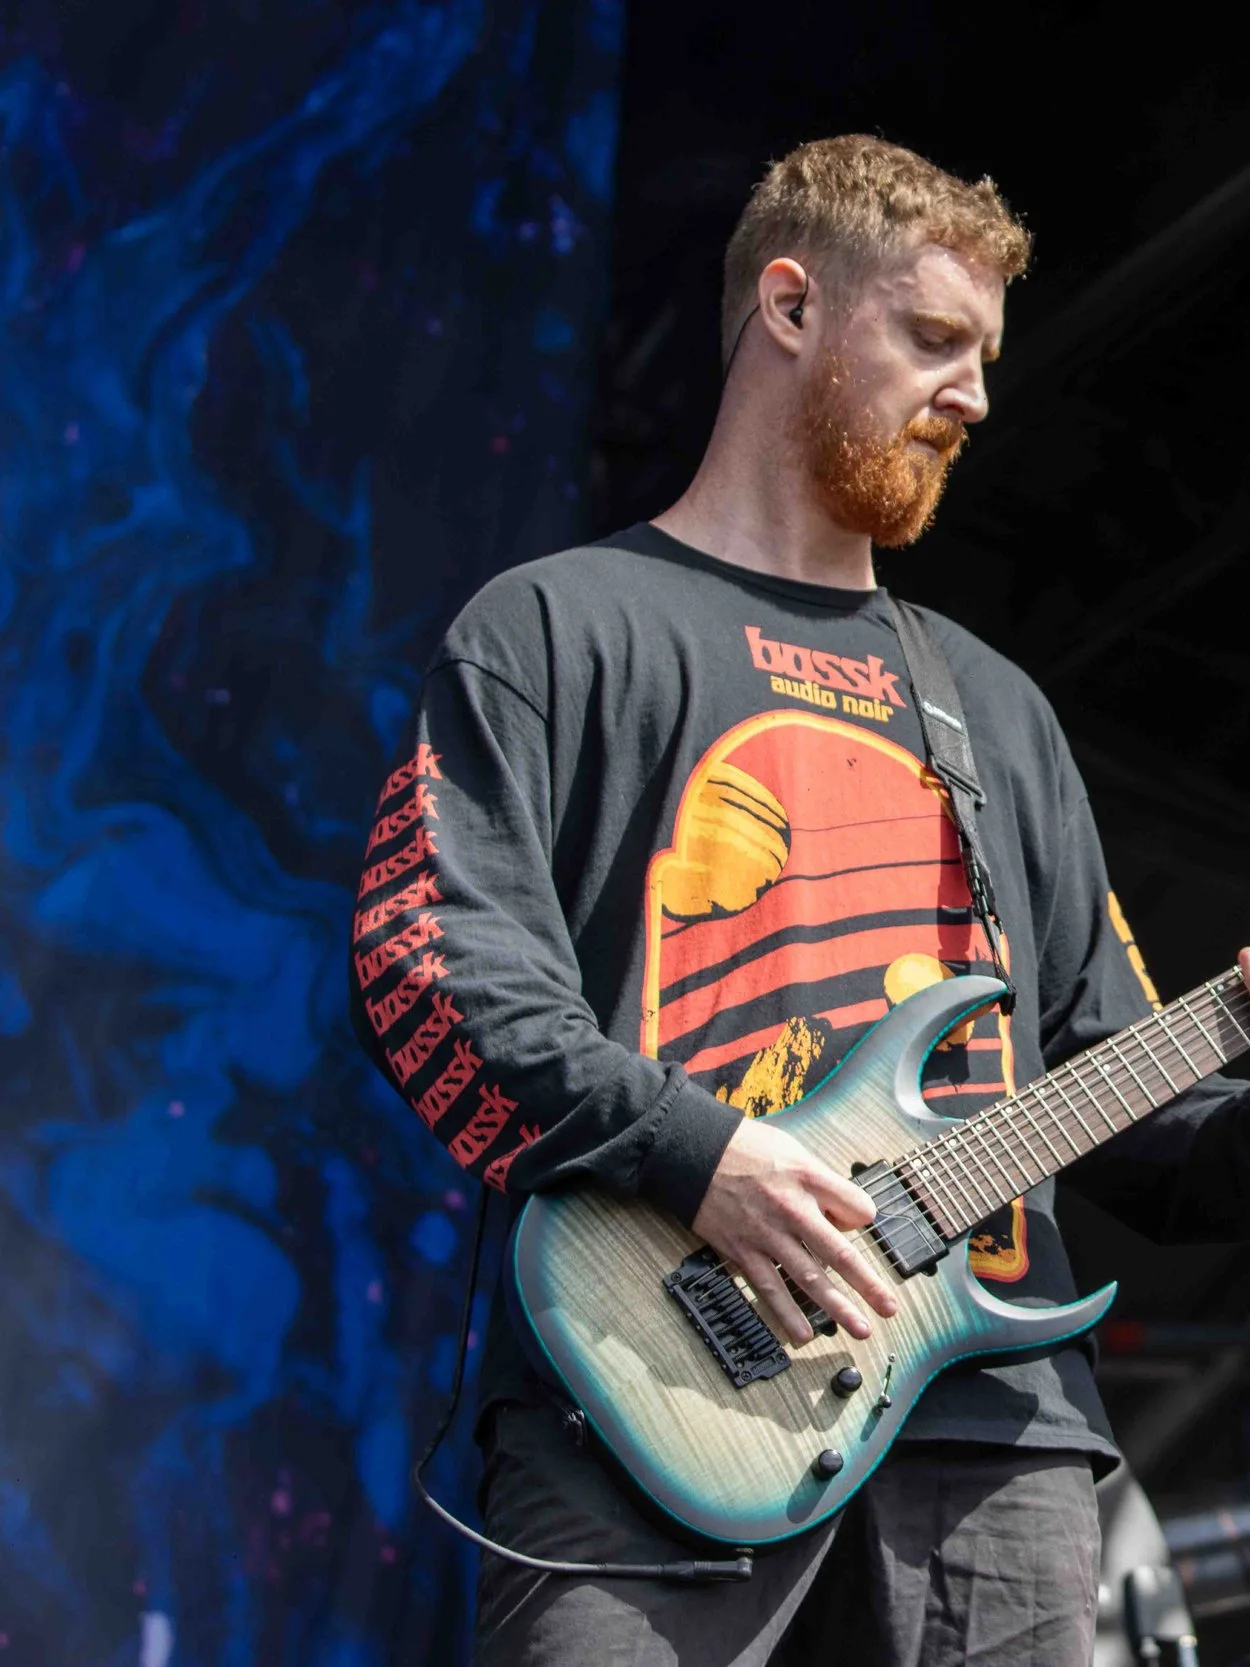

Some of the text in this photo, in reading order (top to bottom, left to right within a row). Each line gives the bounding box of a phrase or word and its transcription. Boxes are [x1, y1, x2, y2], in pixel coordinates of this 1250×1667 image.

[744, 625, 907, 708] bossk
[769, 675, 837, 710] audio
[842, 694, 894, 722] noir
[375, 743, 443, 818] ssk
[365, 783, 439, 860] ossk
[353, 870, 444, 944] bossk
[354, 911, 445, 991] bossk
[365, 951, 450, 1037] bossk
[386, 991, 465, 1088] bossk
